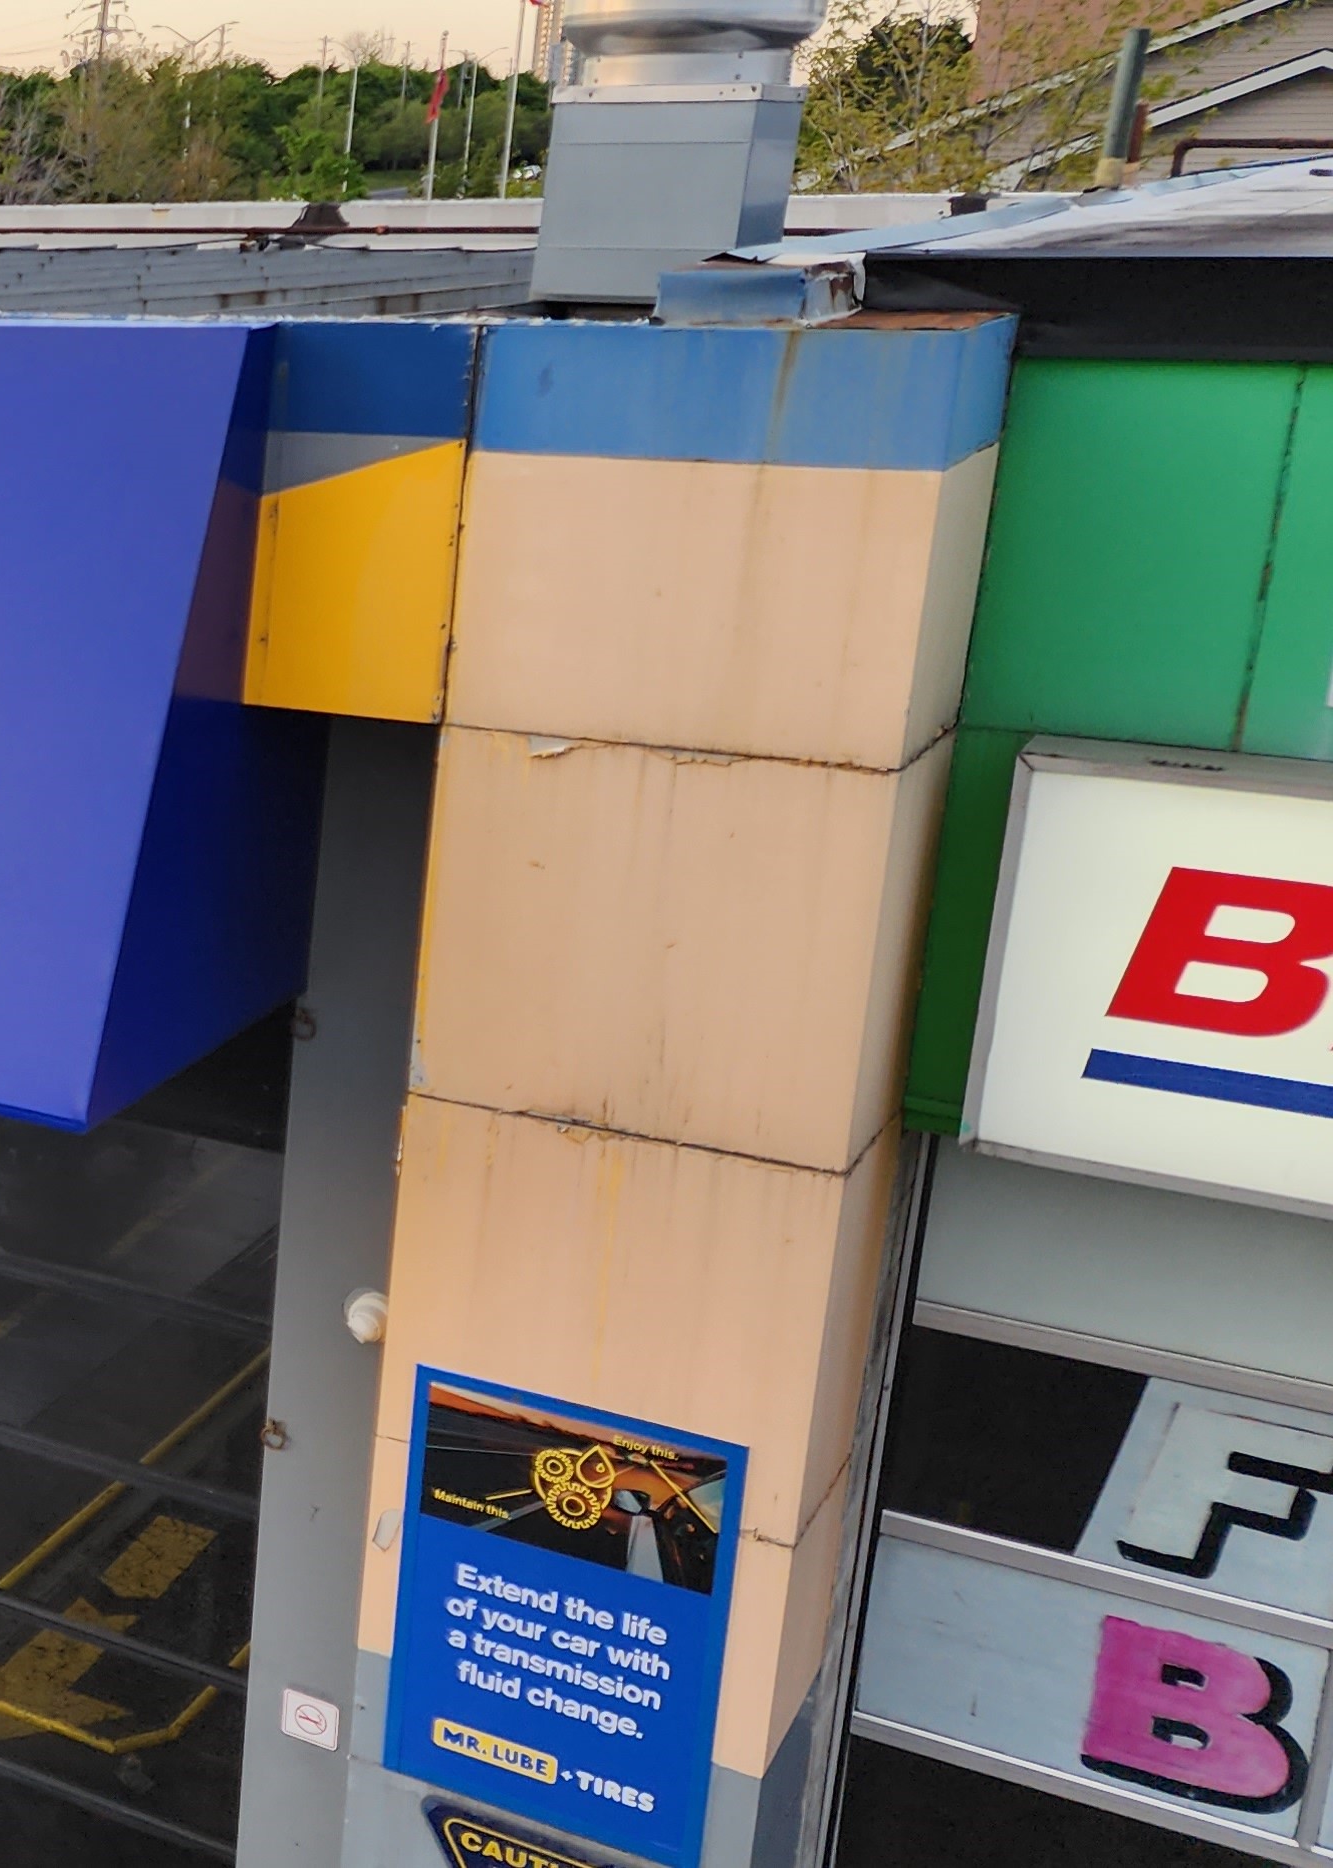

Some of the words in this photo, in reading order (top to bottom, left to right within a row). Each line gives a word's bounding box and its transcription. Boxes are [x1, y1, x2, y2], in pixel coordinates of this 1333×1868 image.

[613, 1434, 651, 1455] Enjoy
[651, 1443, 679, 1461] this.
[433, 1487, 484, 1513] Maintain
[485, 1503, 513, 1521] this.
[455, 1562, 559, 1614] Extend
[563, 1596, 614, 1631] the
[621, 1612, 668, 1646] life
[445, 1597, 478, 1620] of
[481, 1607, 547, 1642] your
[551, 1629, 601, 1658] car
[606, 1645, 671, 1681] with
[447, 1628, 467, 1649] a
[472, 1632, 662, 1711] transmission
[457, 1659, 522, 1700] fluid
[526, 1686, 645, 1740] change.
[442, 1726, 487, 1754] MR.
[492, 1744, 549, 1777] LUBE
[460, 1831, 560, 1868] CAUT
